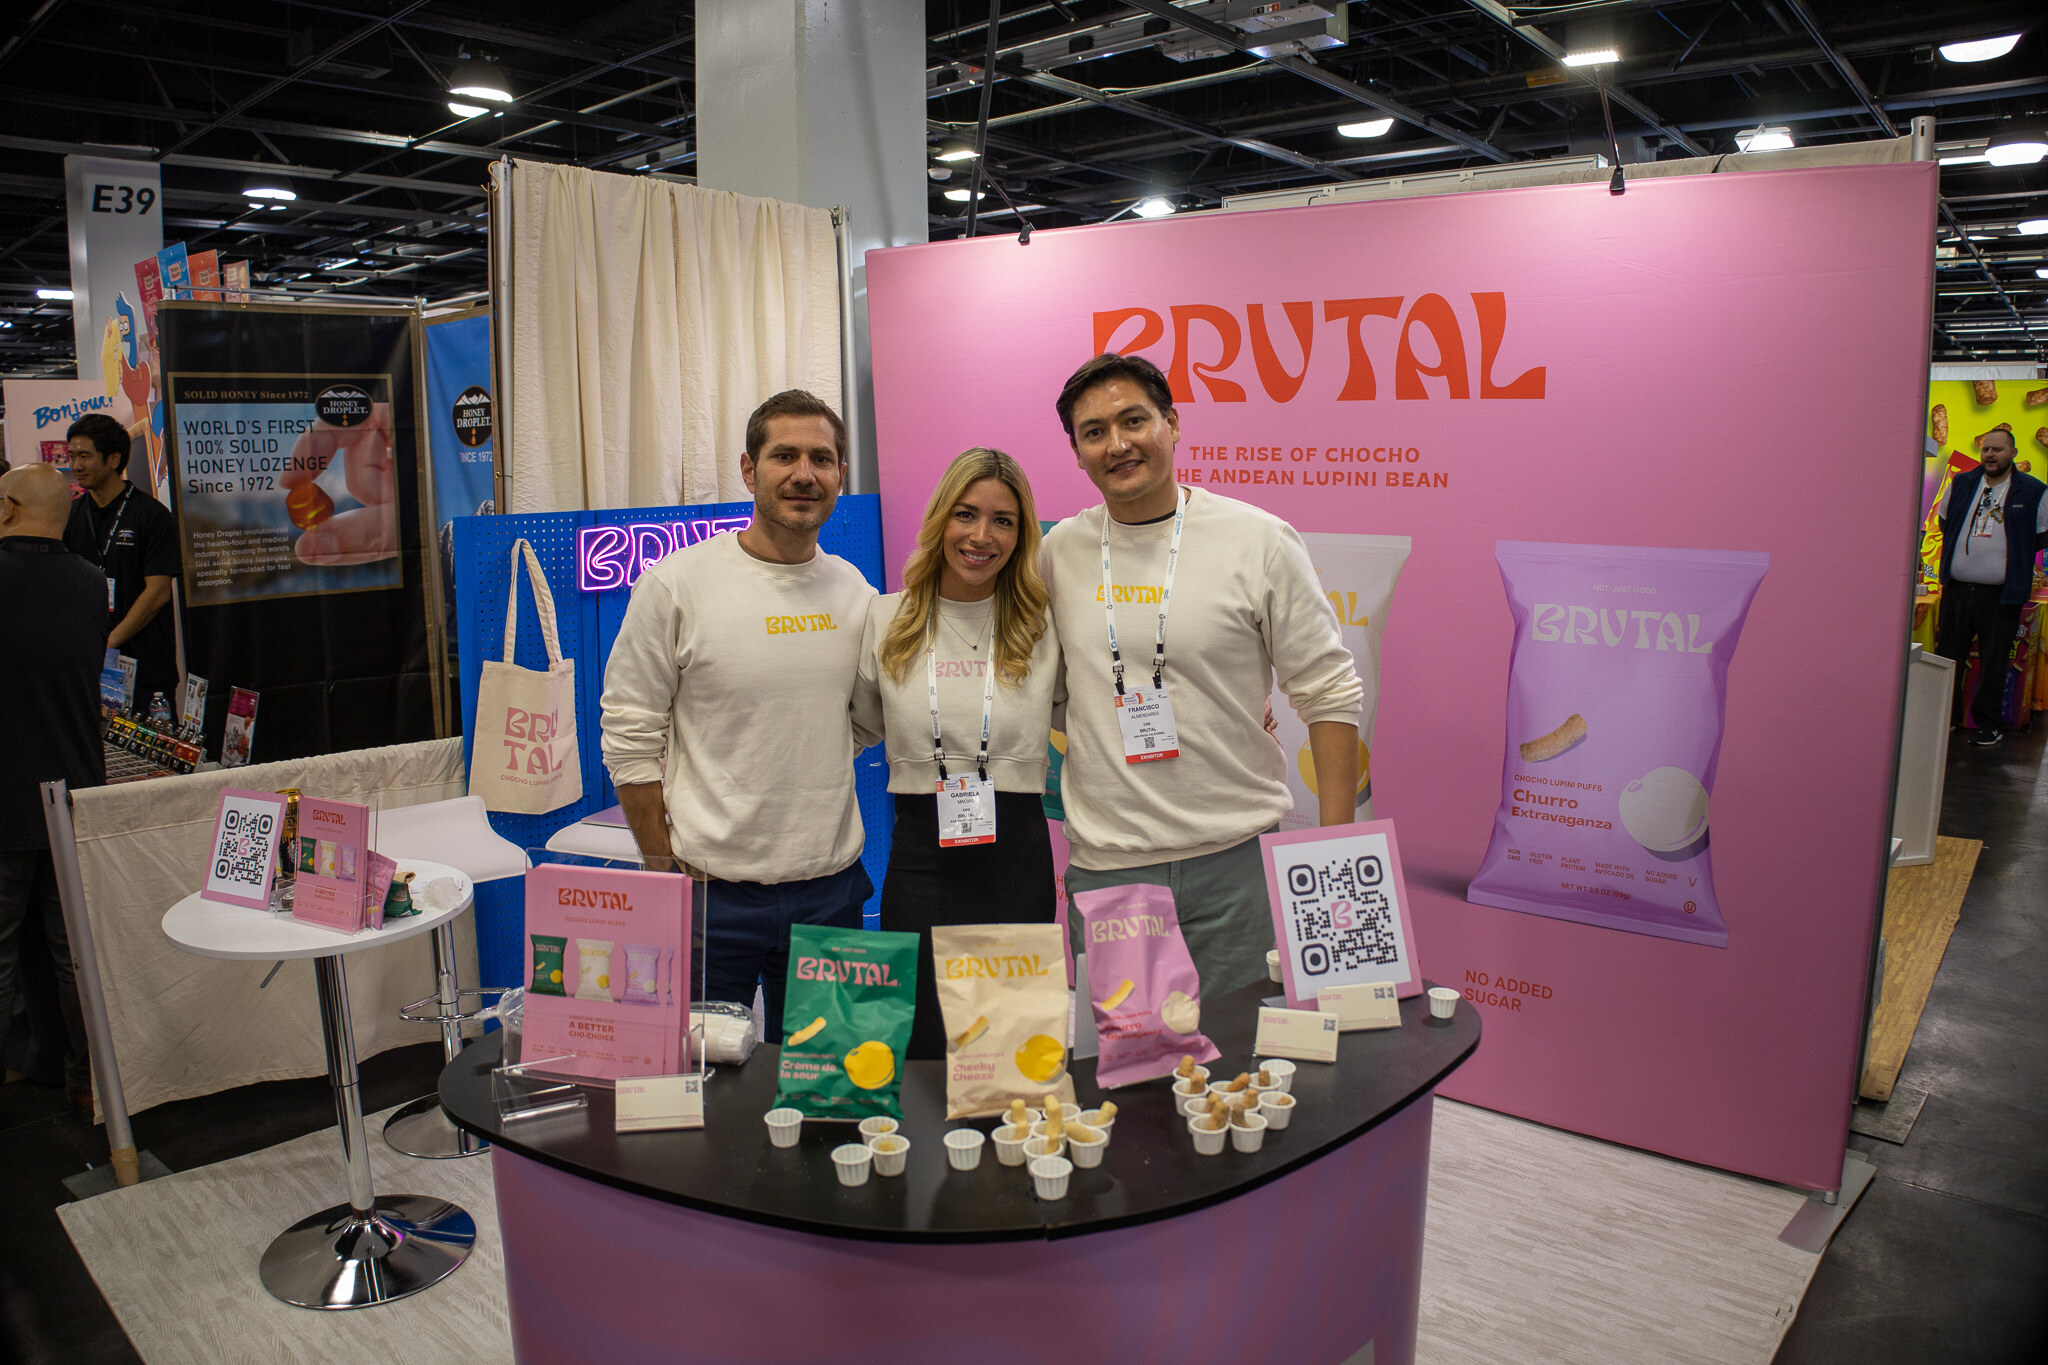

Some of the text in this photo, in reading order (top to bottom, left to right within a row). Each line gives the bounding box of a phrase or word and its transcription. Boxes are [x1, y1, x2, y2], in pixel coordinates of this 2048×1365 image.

[92, 184, 156, 216] E39
[184, 390, 309, 399] SOLID HONEY Since 1972
[32, 395, 114, 430] Bonjour!
[462, 408, 486, 418] HONEY
[183, 419, 316, 436] WORLD'S FIRST
[186, 438, 279, 456] 100% SOLID
[1189, 446, 1420, 463] THE RISE OF CHOCHO
[187, 456, 328, 475] HONEY LOZENGE
[188, 476, 274, 494] Since 1972
[1174, 468, 1449, 489] HE ANDEAN LUPINI BEAN
[216, 530, 242, 538] Droplet
[244, 526, 288, 536] revolutionized
[196, 569, 228, 578] specially
[230, 565, 265, 574] formulated
[1610, 585, 1632, 593] JUST
[1634, 586, 1657, 594] GOOD
[765, 613, 838, 635] BRUTAL
[1531, 603, 1713, 654] BRUTAL
[1128, 704, 1160, 713] FRANCISCO
[503, 739, 563, 775] TAL
[500, 774, 528, 784] CHOCHO
[1514, 774, 1603, 792] CHOCHO LUPINI PUFFS
[1512, 788, 1579, 810] Churro
[312, 809, 347, 826] BRUTAL
[1511, 805, 1613, 830] Extravaganza
[1529, 852, 1553, 860] GLUTEN
[1561, 856, 1581, 865] PLANT
[1595, 862, 1612, 870] MADE
[1656, 872, 1678, 880] ADDED
[1560, 863, 1586, 872] PROTEIN
[1594, 868, 1625, 878] AVOCADO
[1645, 877, 1667, 885] SUGAR
[1561, 882, 1574, 890] NET
[1576, 885, 1588, 893] WT
[558, 887, 634, 912] BRUTAL
[1091, 914, 1171, 944] BRUTAL
[796, 956, 899, 987] BRUTAL
[945, 954, 1049, 981] BRUTAL
[1465, 969, 1553, 1000] NO ADDED
[1463, 987, 1522, 1012] SUGAR
[569, 1021, 614, 1033] A BETTER
[1105, 1022, 1142, 1032] urro
[780, 1069, 820, 1080] la sour
[821, 1062, 837, 1072] de
[954, 1062, 996, 1072] Cheeky
[953, 1072, 994, 1082] Cheeze
